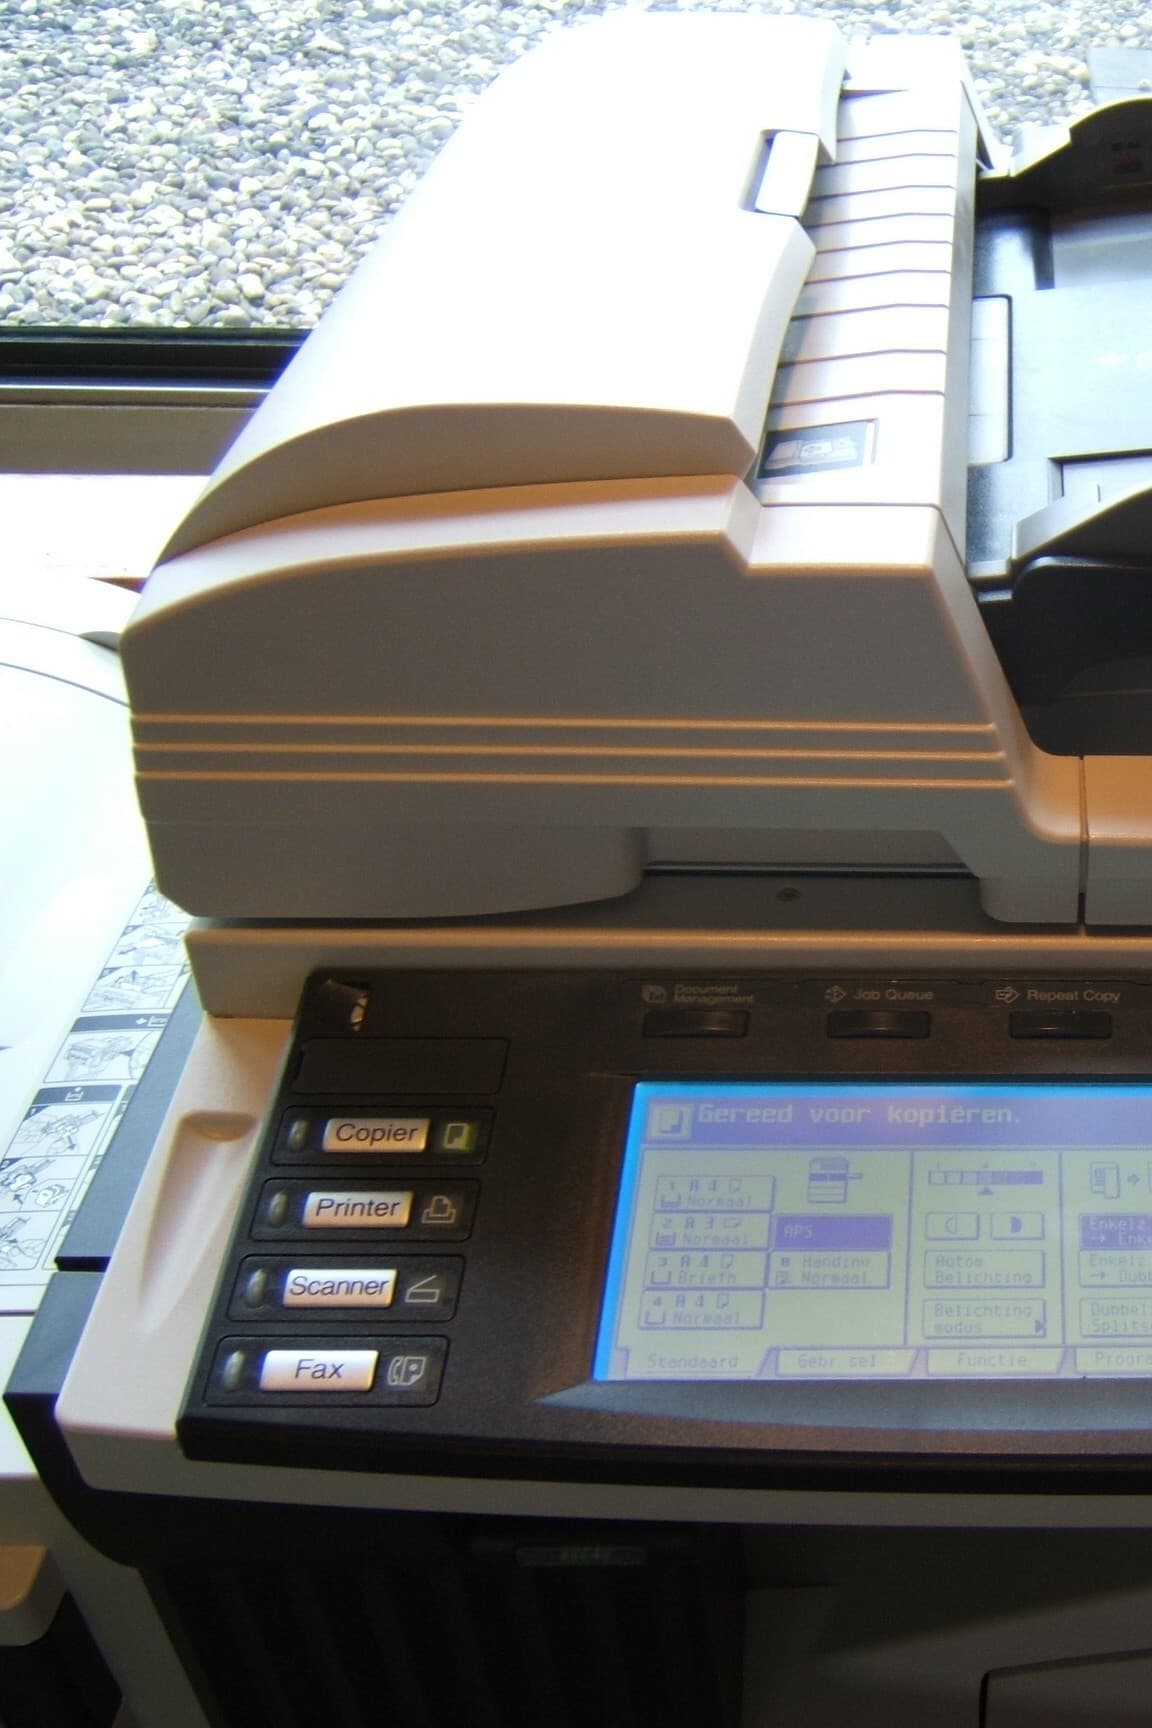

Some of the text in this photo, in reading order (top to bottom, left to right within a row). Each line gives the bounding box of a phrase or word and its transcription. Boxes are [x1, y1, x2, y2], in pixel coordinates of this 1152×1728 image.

[853, 988, 933, 1001] Job Queue
[1028, 988, 1121, 1003] Repeat Copy
[698, 1103, 1021, 1127] Gereed voor kopieren.
[335, 1122, 419, 1147] Copier
[315, 1197, 401, 1218] Printer
[1089, 1217, 1147, 1231] Enkelz
[784, 1225, 814, 1239] APS
[289, 1273, 390, 1298] Scanner
[935, 1271, 1033, 1286] Belichting
[934, 1303, 1033, 1319] Belichting
[647, 1354, 739, 1368] Standaard
[957, 1353, 1027, 1368] Functie
[294, 1358, 345, 1380] Fax
